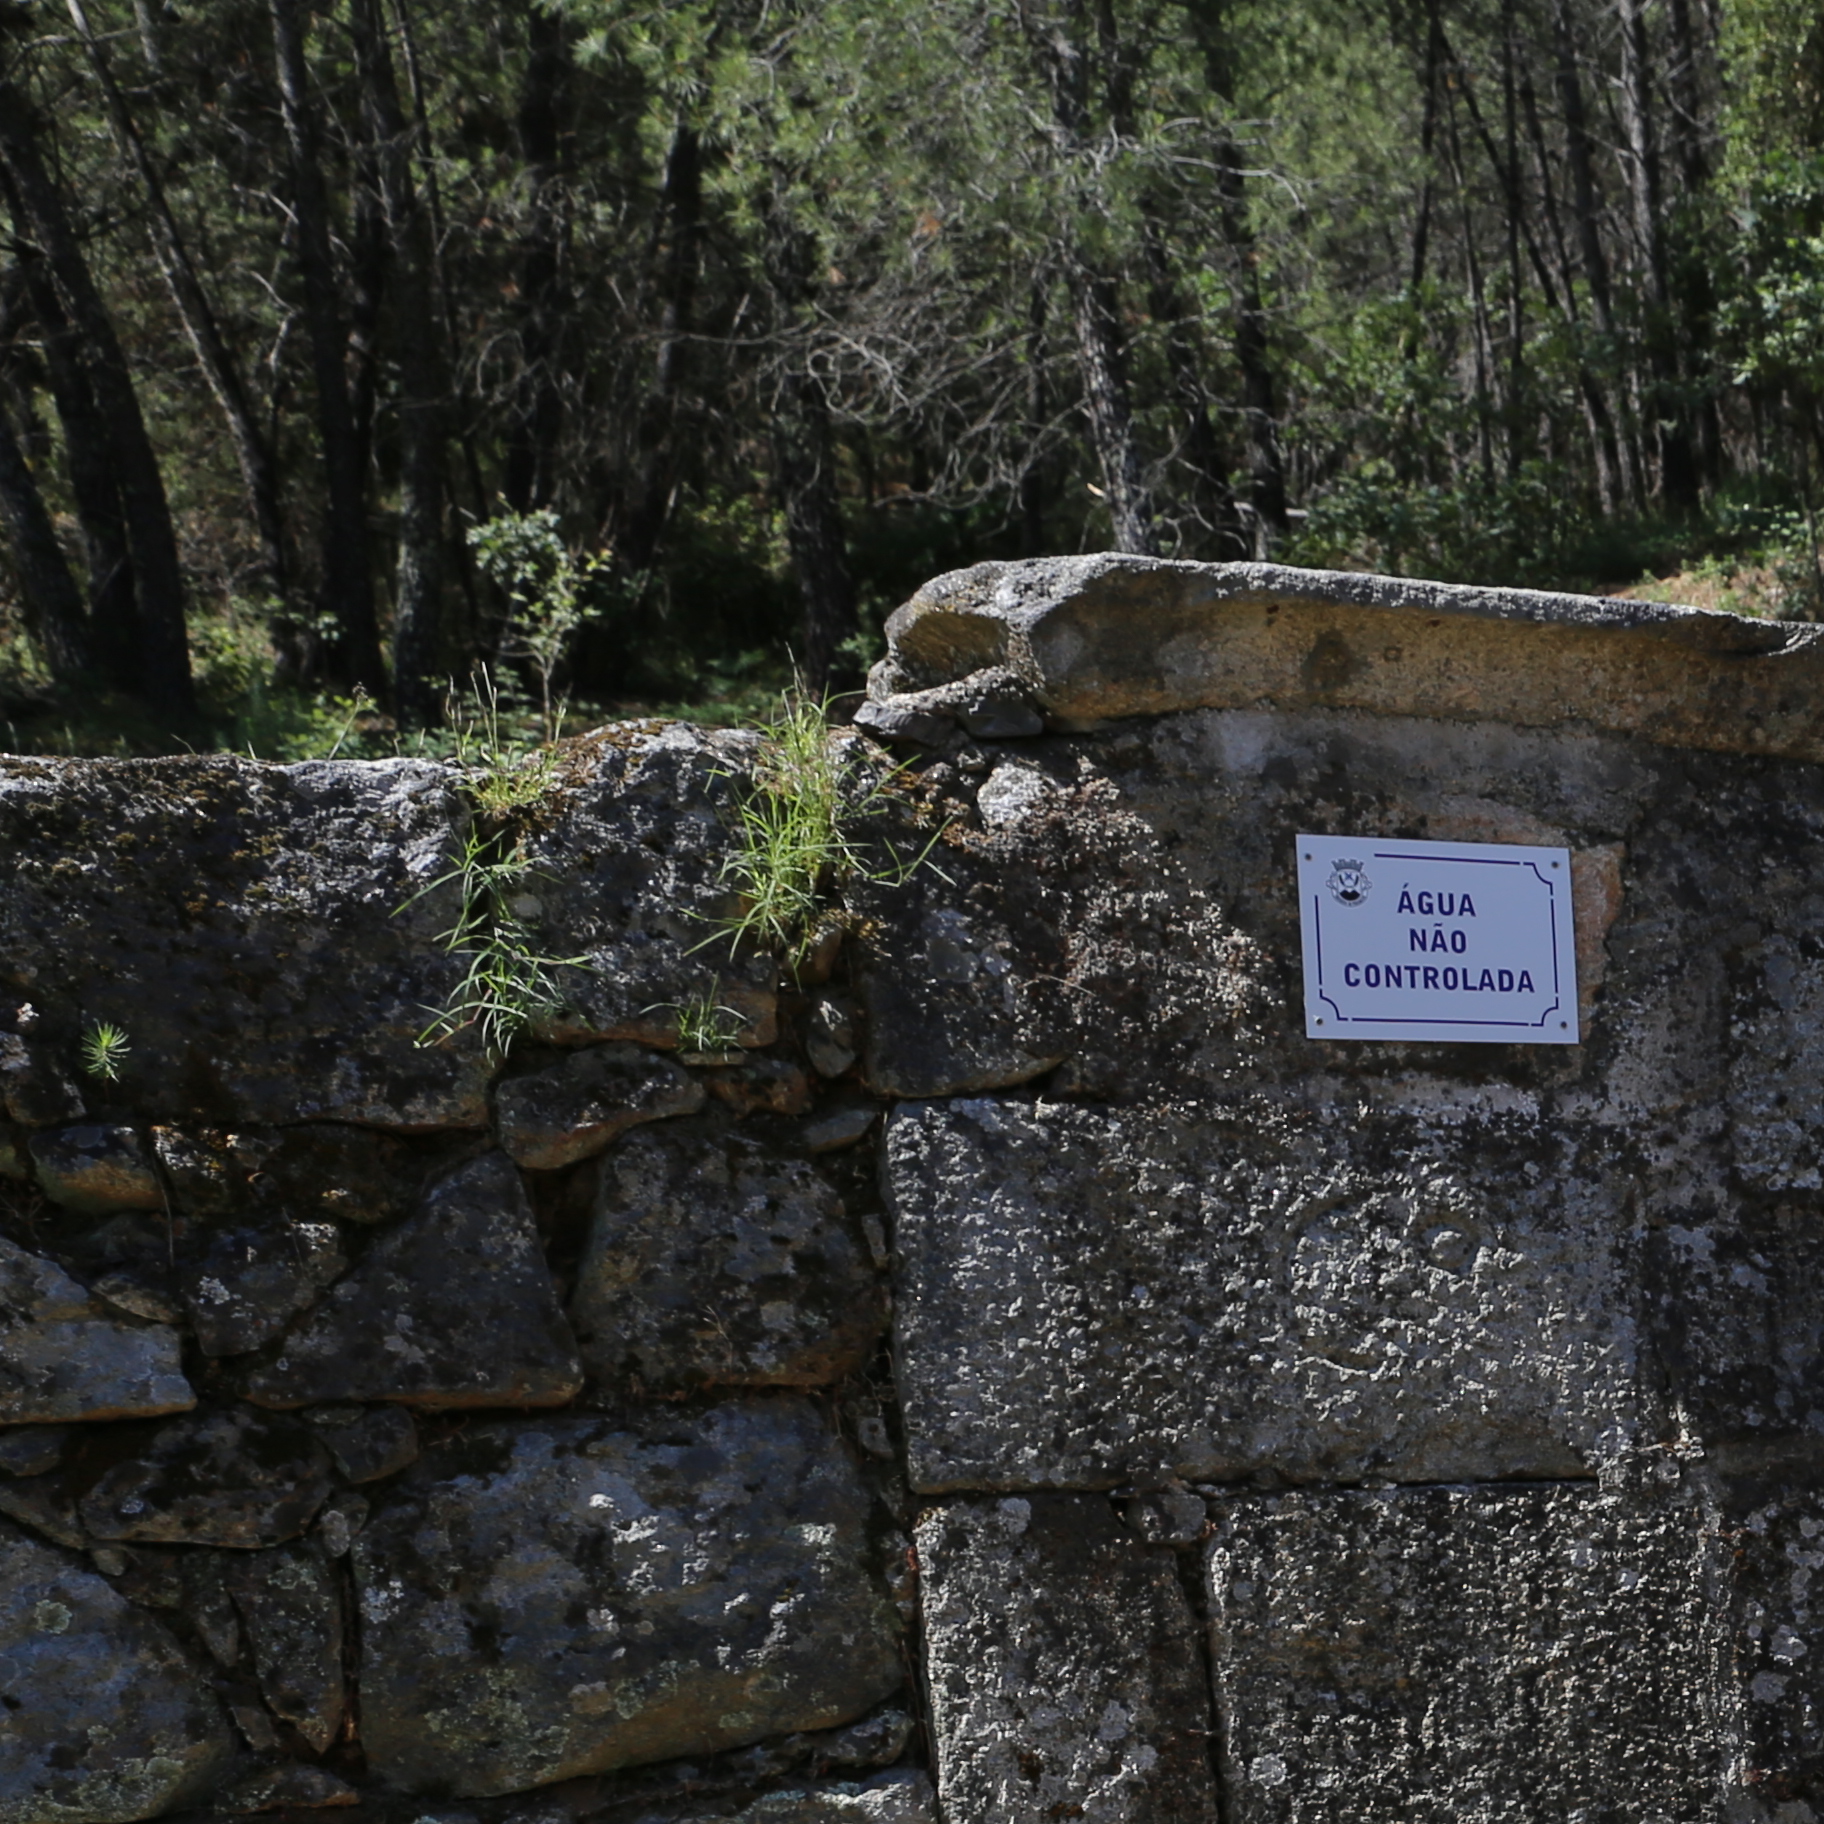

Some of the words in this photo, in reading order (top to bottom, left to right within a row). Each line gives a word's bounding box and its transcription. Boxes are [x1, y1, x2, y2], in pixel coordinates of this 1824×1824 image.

[1397, 883, 1477, 917] ÁGUA
[1409, 923, 1467, 954] NÃO
[1344, 963, 1535, 993] CONTROLADA
